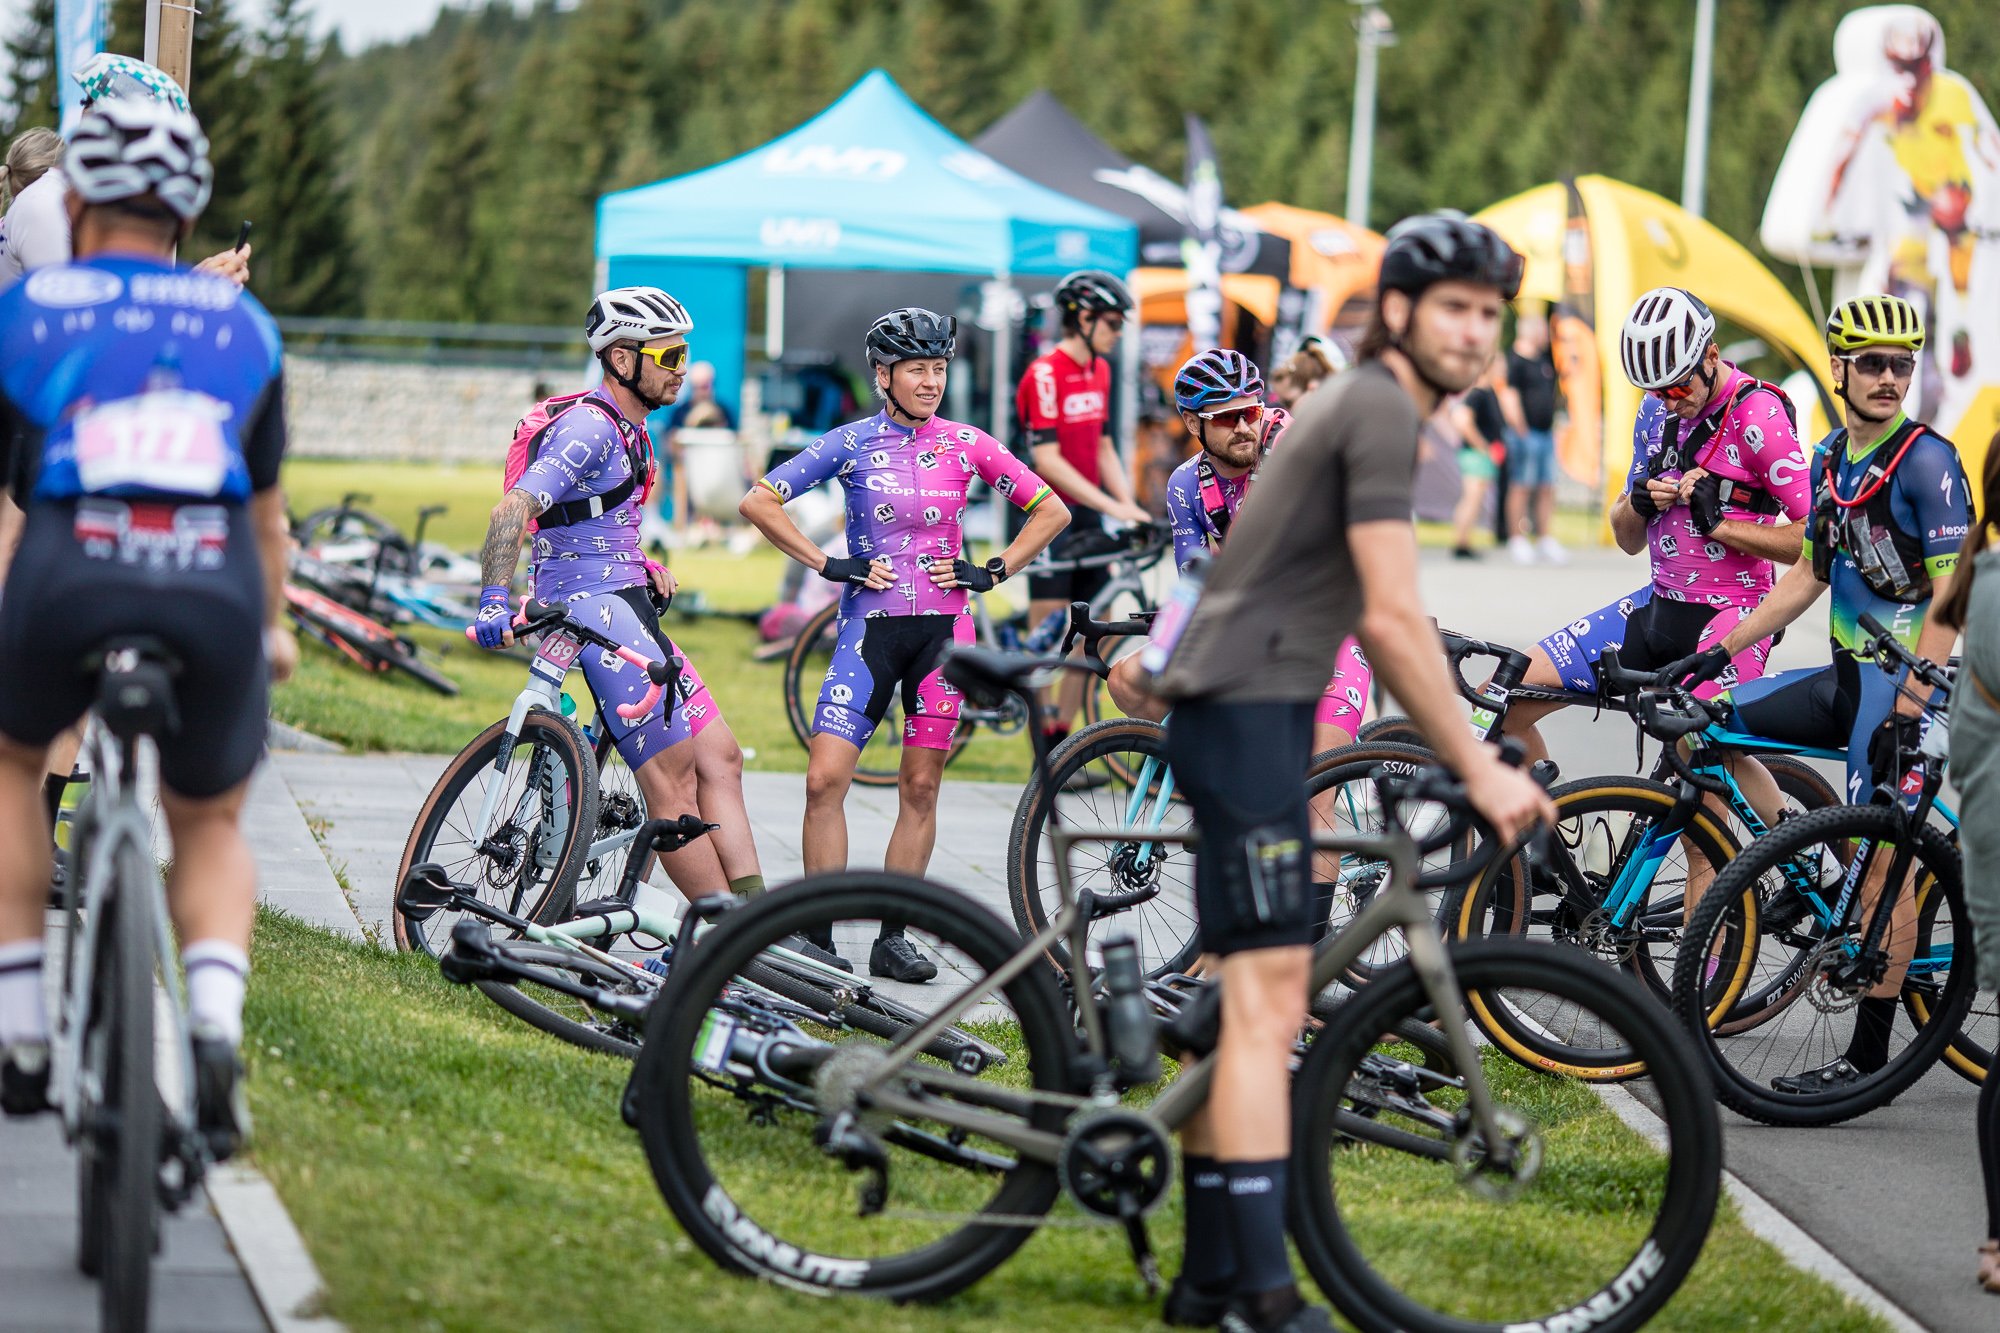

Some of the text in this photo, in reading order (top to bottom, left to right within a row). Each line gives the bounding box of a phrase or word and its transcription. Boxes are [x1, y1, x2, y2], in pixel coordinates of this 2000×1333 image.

[611, 318, 647, 329] SCOTT
[882, 486, 960, 497] top team
[544, 637, 574, 662] 189
[1544, 638, 1566, 668] team
[1556, 641, 1572, 665] top
[1508, 688, 1573, 700] SCOTT
[819, 720, 854, 737] team
[833, 717, 857, 731] top
